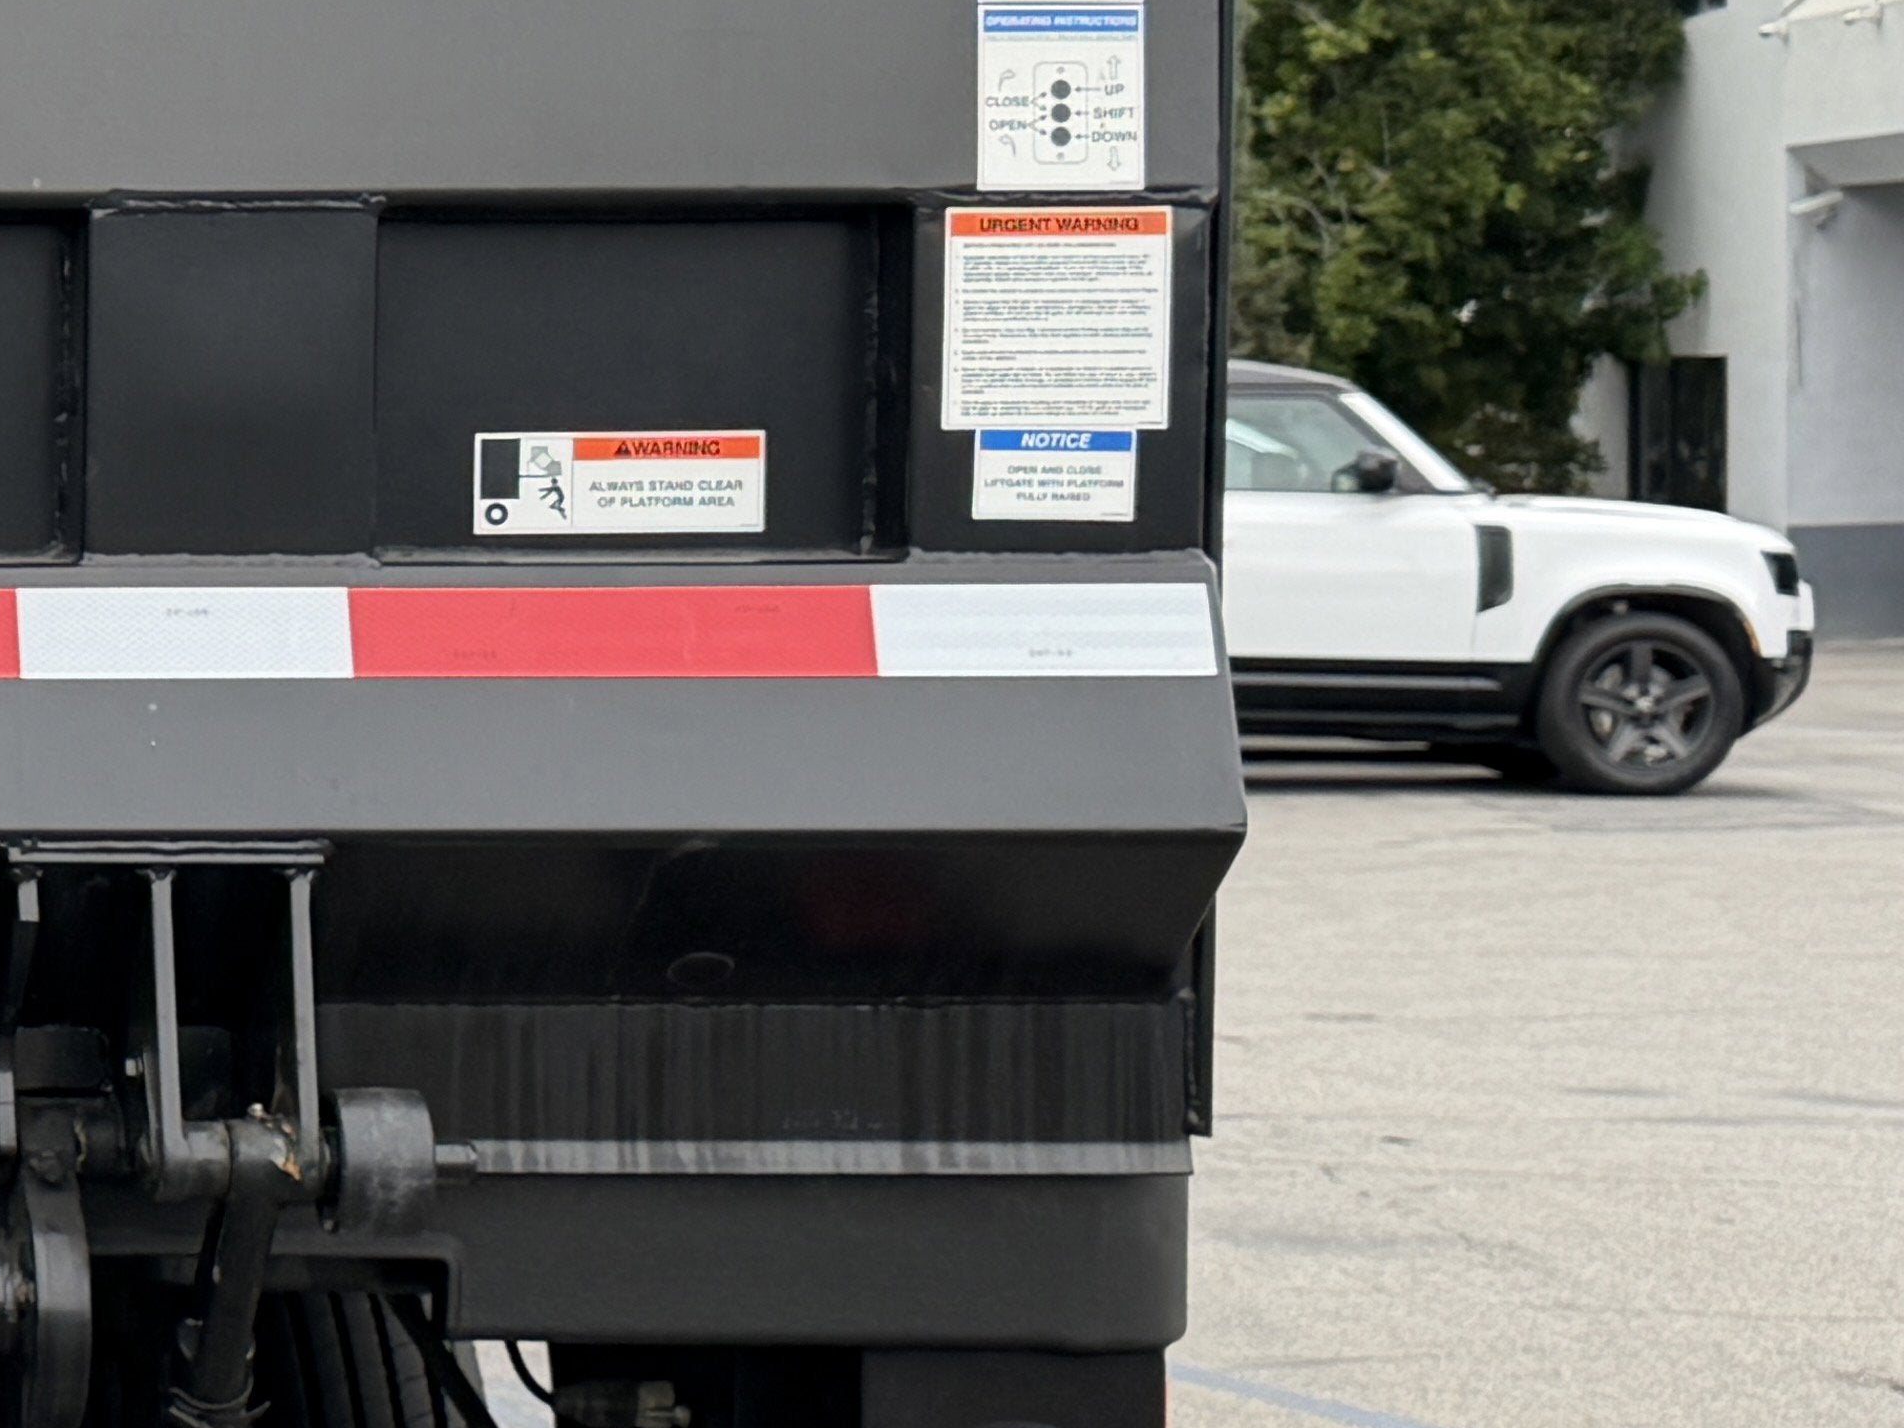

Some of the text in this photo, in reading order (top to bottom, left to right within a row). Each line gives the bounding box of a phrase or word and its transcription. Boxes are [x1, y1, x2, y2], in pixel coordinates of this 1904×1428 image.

[1104, 84, 1124, 95] UP
[985, 96, 1029, 107] CLOSE
[1093, 107, 1134, 119] SHIFT
[989, 120, 1027, 130] OPEN
[1092, 131, 1137, 142] DOWN
[980, 217, 1139, 232] URGENT WARNING
[1020, 433, 1092, 448] NOTICE
[632, 440, 721, 456] WARNING
[1007, 465, 1038, 475] OPEN
[1041, 465, 1064, 475] AND
[589, 480, 744, 492] ALWAYS STAND CLEAR
[1067, 478, 1124, 487] PLATFORM
[597, 496, 736, 508] OF PLATFORM AREA
